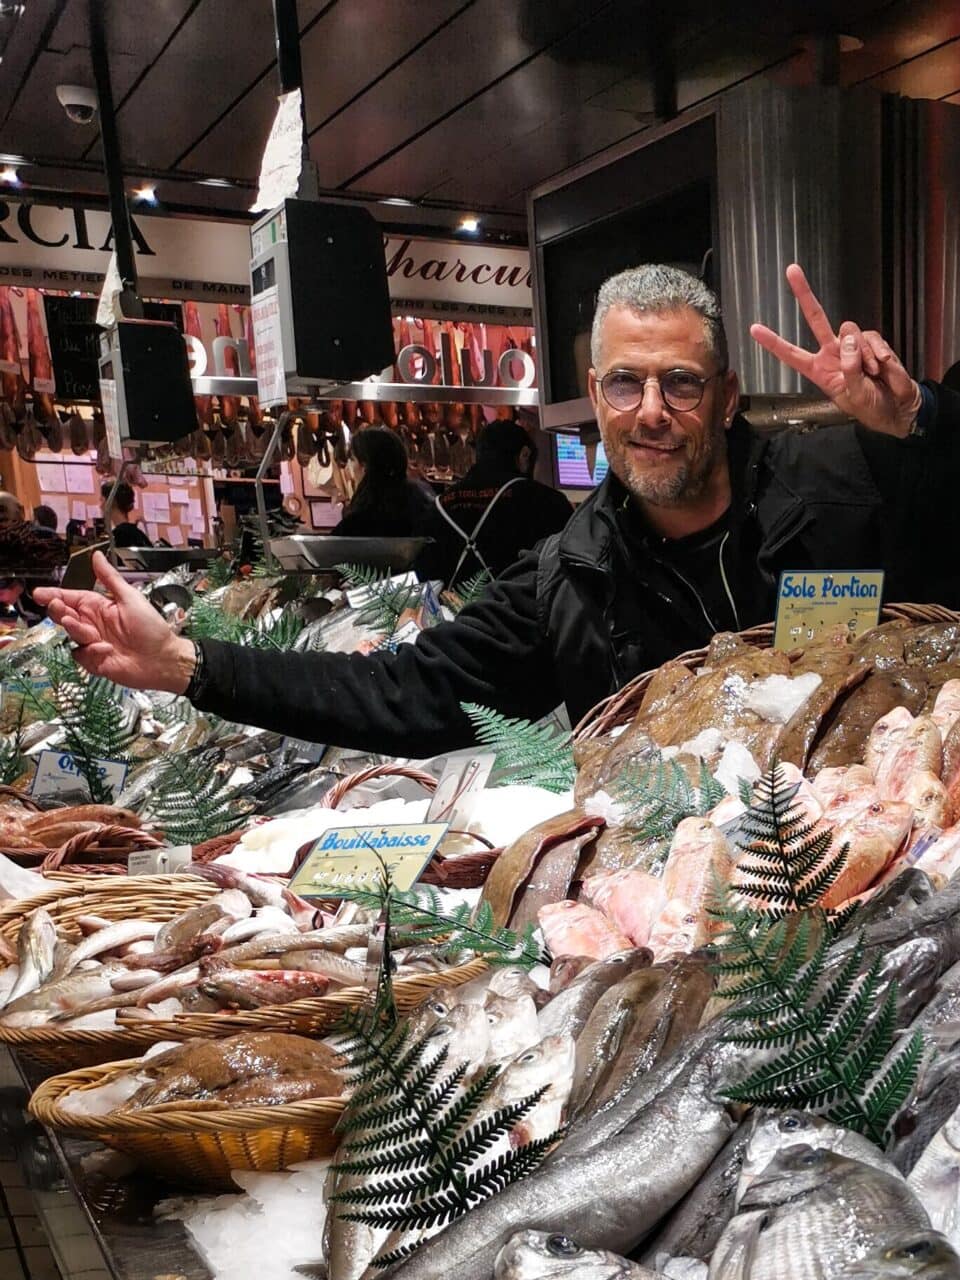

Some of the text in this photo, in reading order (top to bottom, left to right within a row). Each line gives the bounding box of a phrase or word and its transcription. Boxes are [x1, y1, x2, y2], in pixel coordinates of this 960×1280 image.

[383, 237, 532, 289] harcu
[203, 283, 246, 295] MAIN
[782, 576, 878, 598] Sole Portion
[320, 830, 431, 850] Bouillabaisse
